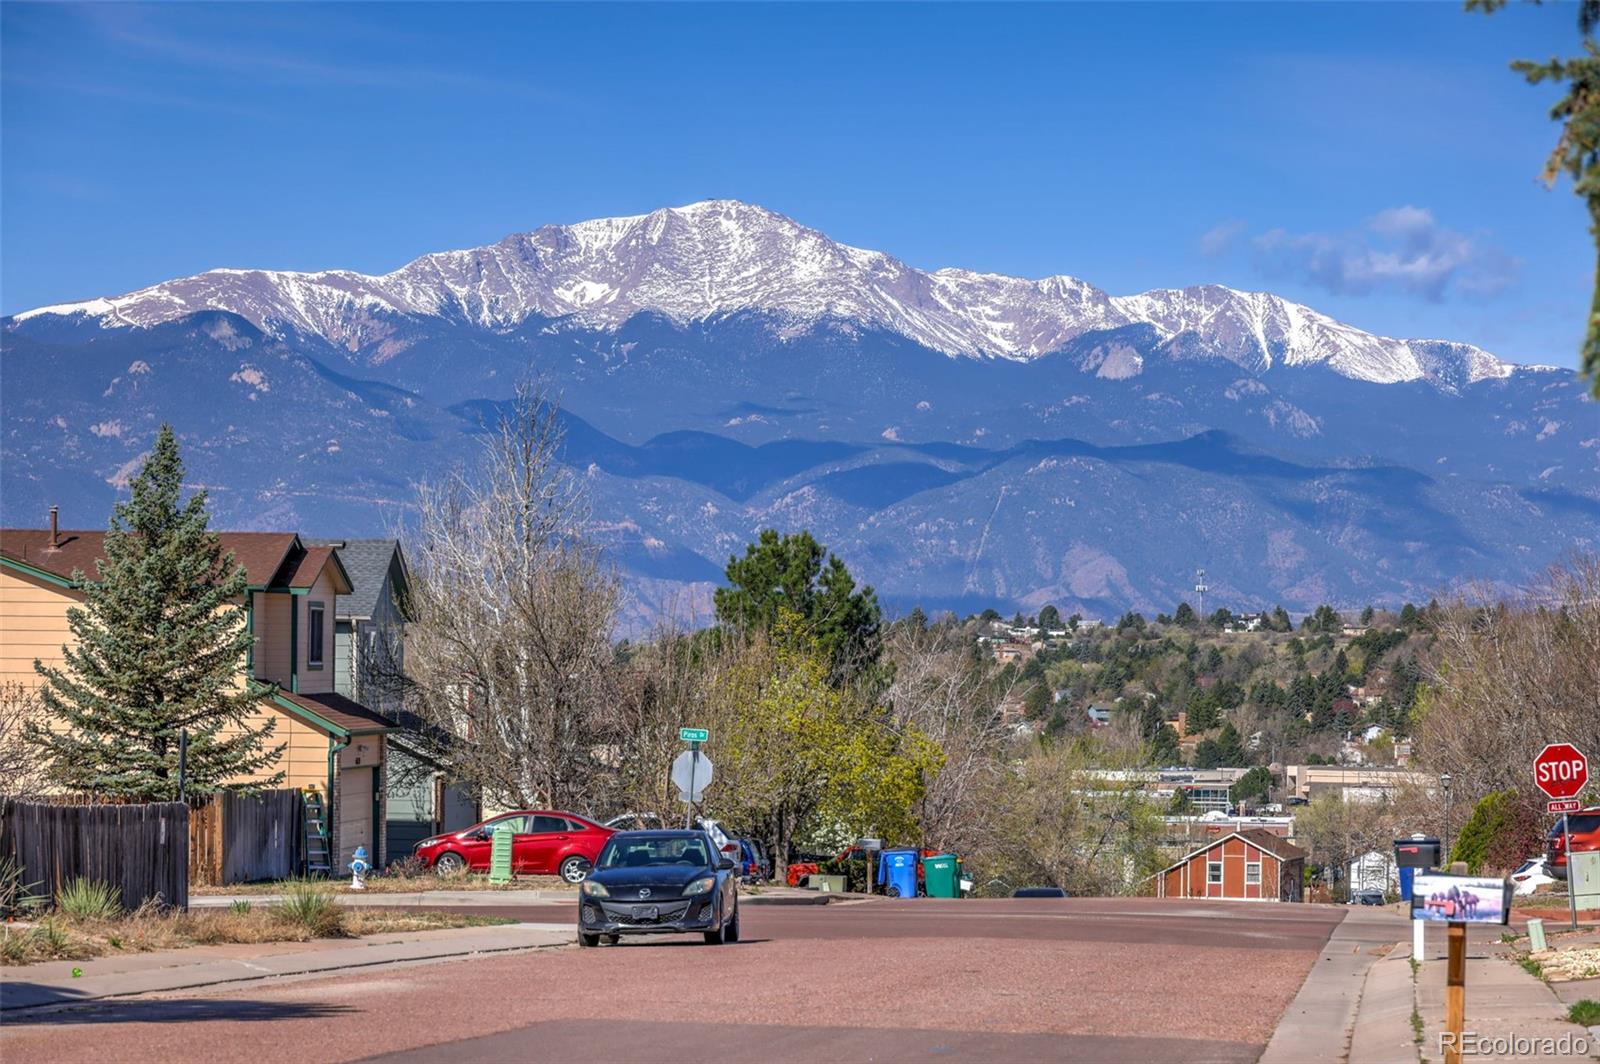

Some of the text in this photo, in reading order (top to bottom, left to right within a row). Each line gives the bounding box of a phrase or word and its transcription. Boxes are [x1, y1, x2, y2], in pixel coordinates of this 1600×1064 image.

[1538, 760, 1584, 782] STOP
[1551, 802, 1577, 811] ALL WAY
